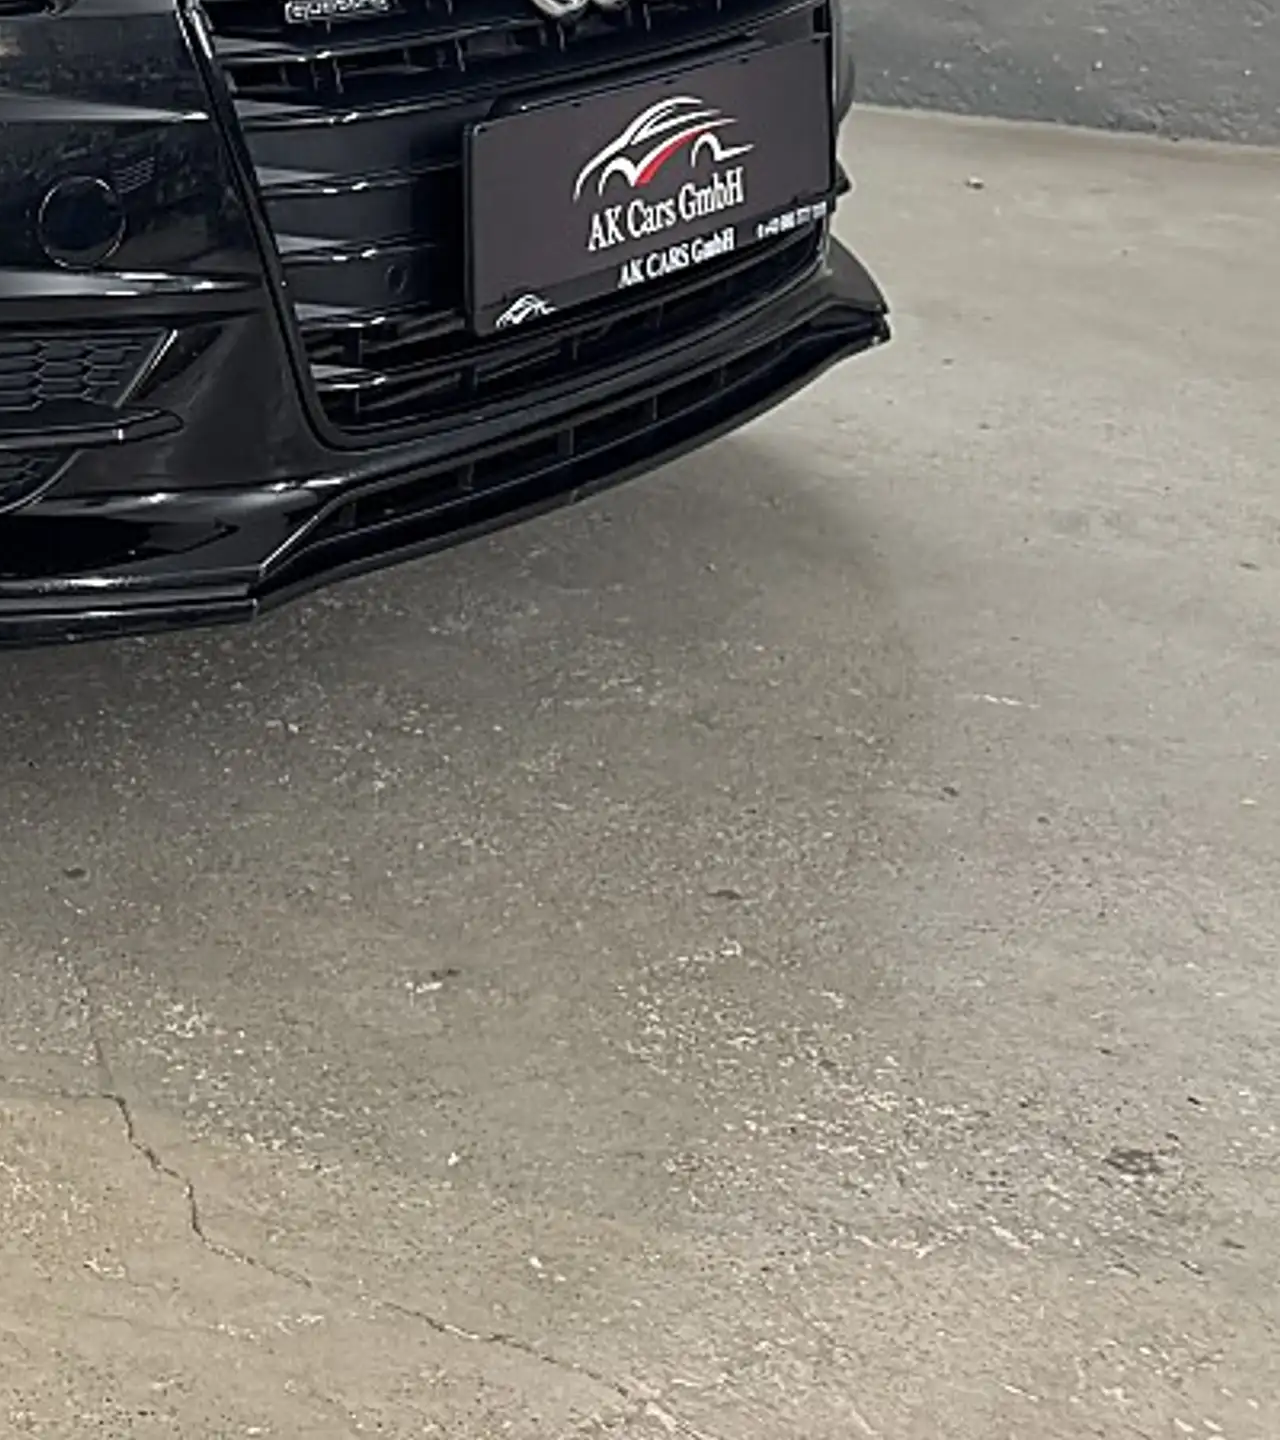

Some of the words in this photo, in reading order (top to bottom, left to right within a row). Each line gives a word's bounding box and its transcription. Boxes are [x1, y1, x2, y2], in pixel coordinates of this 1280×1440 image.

[587, 204, 626, 252] AK
[626, 197, 677, 239] Cars
[678, 166, 745, 221] GmbH
[617, 258, 645, 289] AK
[646, 243, 690, 279] CARS
